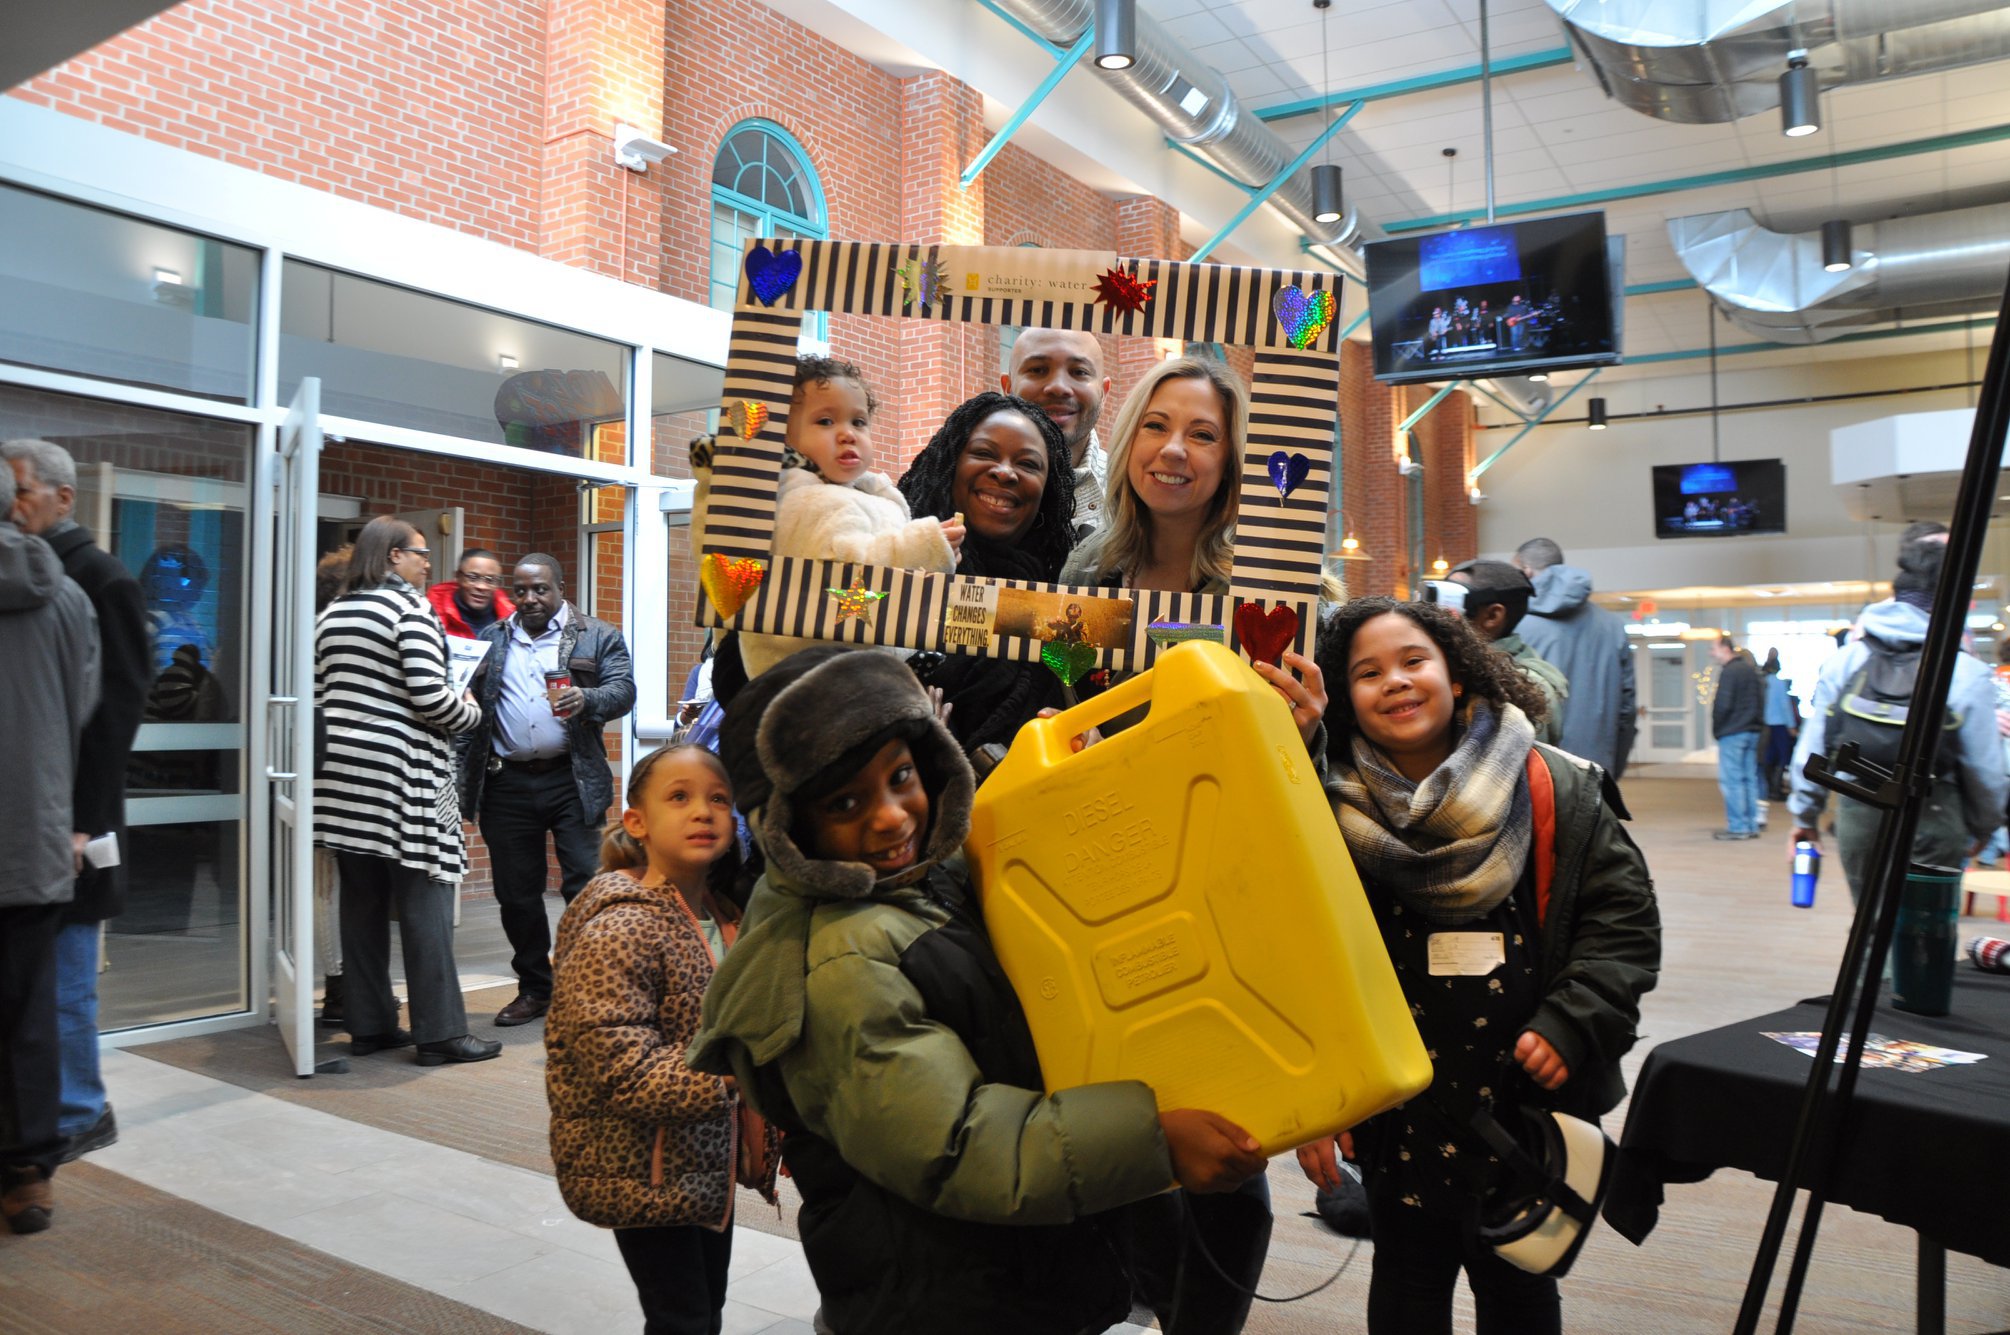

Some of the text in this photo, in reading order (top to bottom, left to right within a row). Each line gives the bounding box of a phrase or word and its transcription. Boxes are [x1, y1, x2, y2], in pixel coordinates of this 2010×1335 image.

[988, 274, 1087, 290] charity: water
[960, 584, 985, 602] WATER
[953, 605, 986, 624] CHANGES
[944, 625, 989, 647] EVERYTHING.
[1063, 790, 1135, 837] DIESEL
[1063, 818, 1156, 875] DANGER
